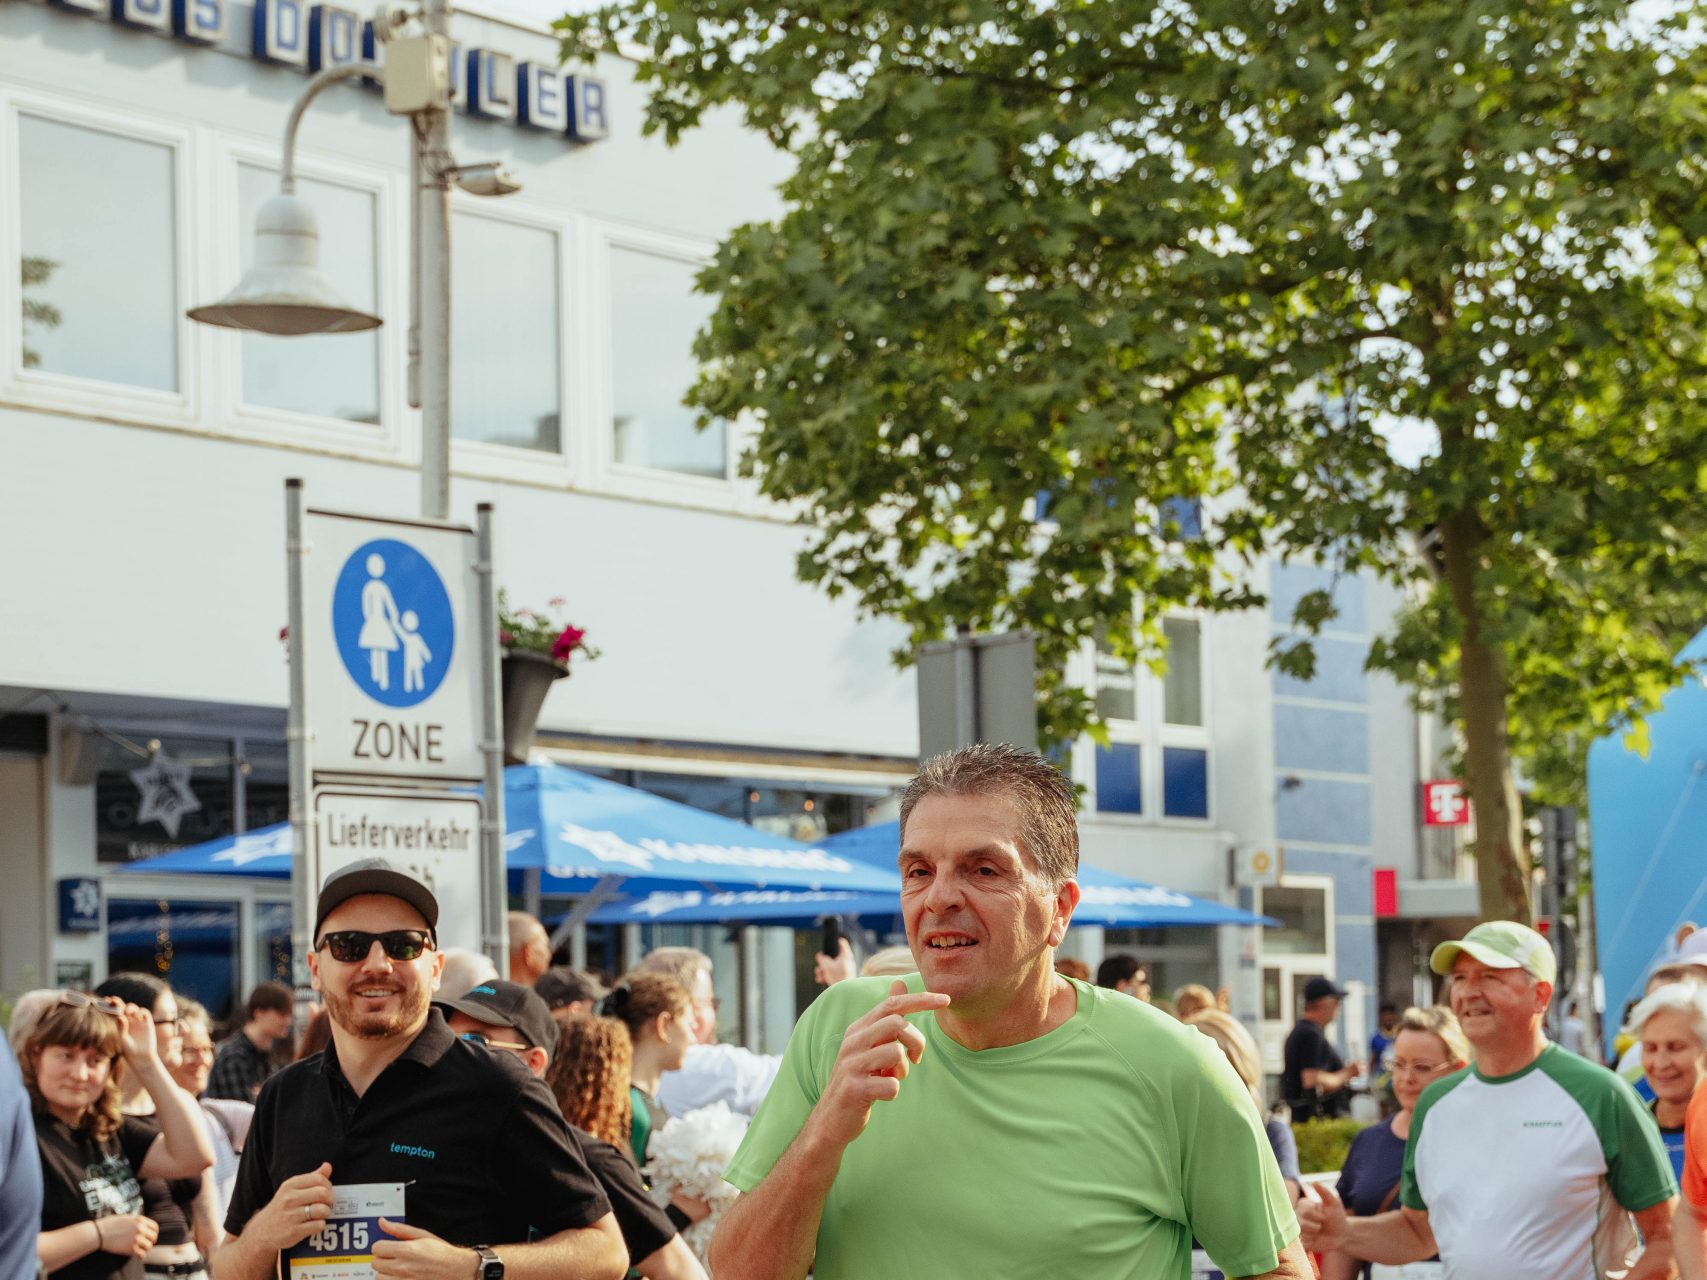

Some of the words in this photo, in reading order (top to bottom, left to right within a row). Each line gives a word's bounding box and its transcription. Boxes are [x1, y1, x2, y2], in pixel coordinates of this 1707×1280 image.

[352, 719, 446, 763] ZONE
[327, 813, 472, 851] Lieferverkehr
[390, 1141, 436, 1160] tempton
[309, 1221, 369, 1252] 4515
